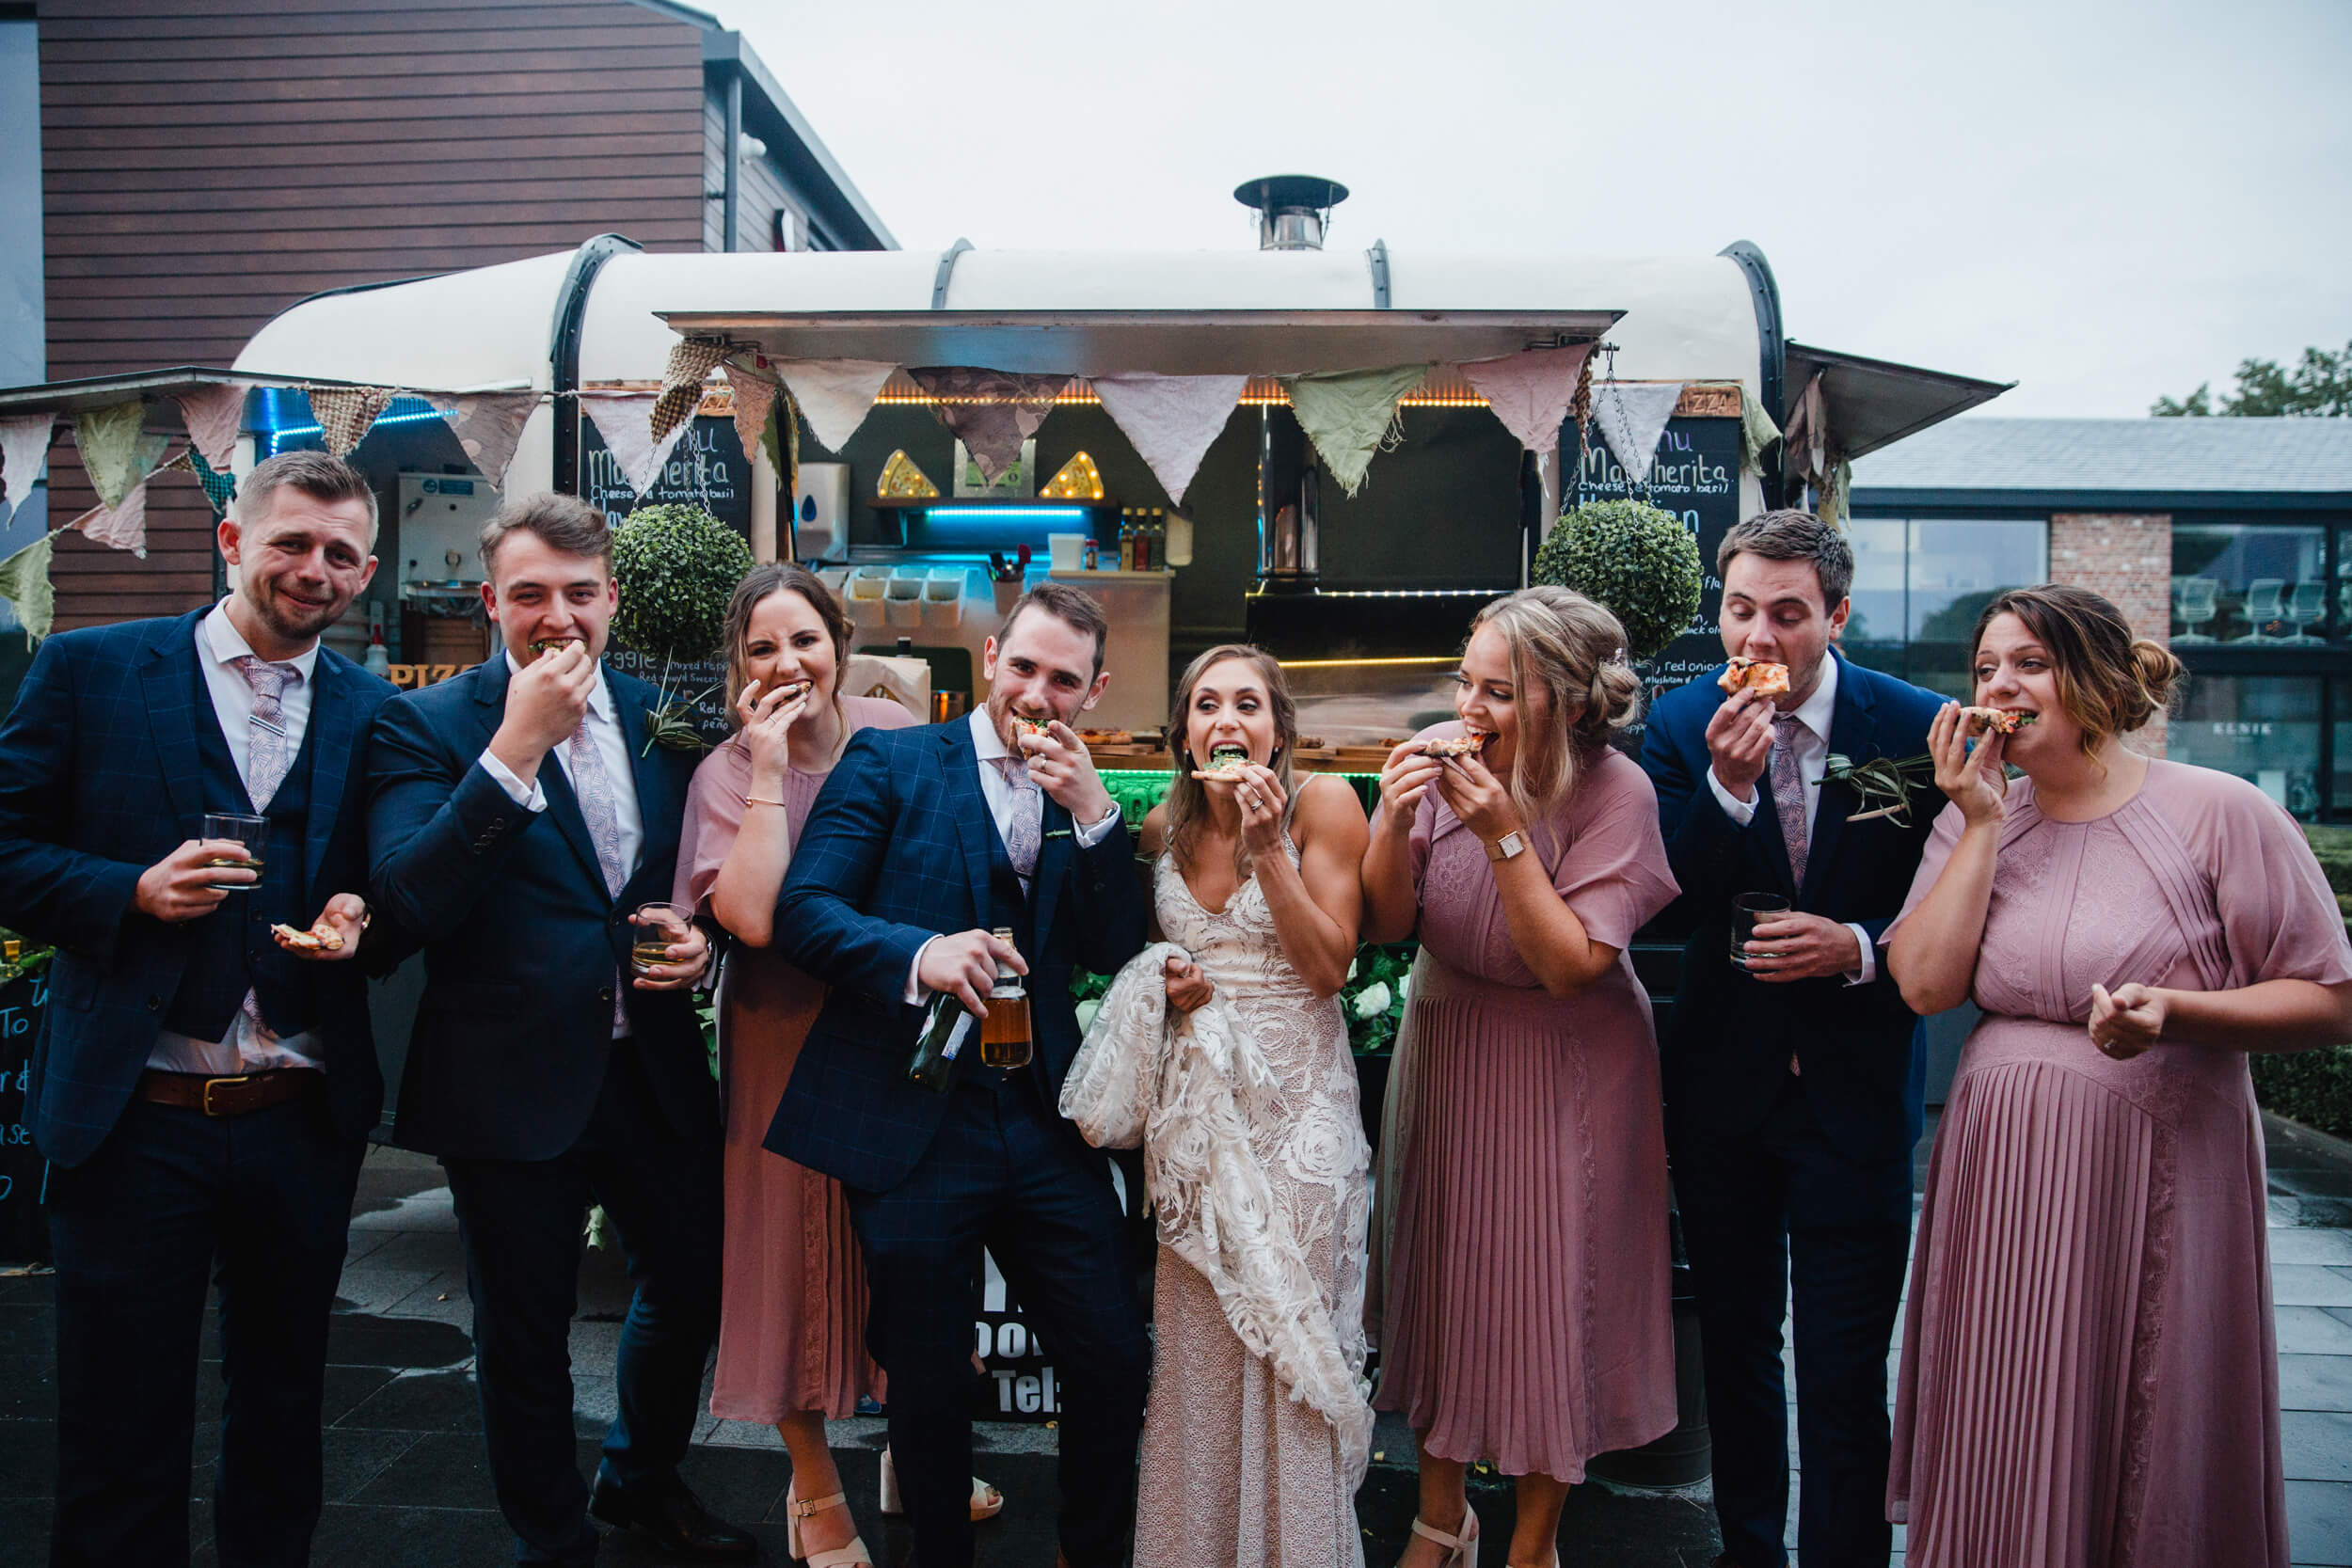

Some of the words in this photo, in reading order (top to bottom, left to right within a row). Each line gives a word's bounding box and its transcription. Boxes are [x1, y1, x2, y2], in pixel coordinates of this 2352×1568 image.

[1683, 393, 1728, 413] IZZA
[675, 428, 718, 451] nu
[1658, 430, 1693, 451] nu
[1581, 447, 1729, 486] Maherita
[709, 488, 735, 499] basil
[602, 650, 658, 670] eggie
[1664, 658, 1686, 673] red
[388, 663, 476, 689] PIZ
[992, 1366, 1062, 1414] Tel:
